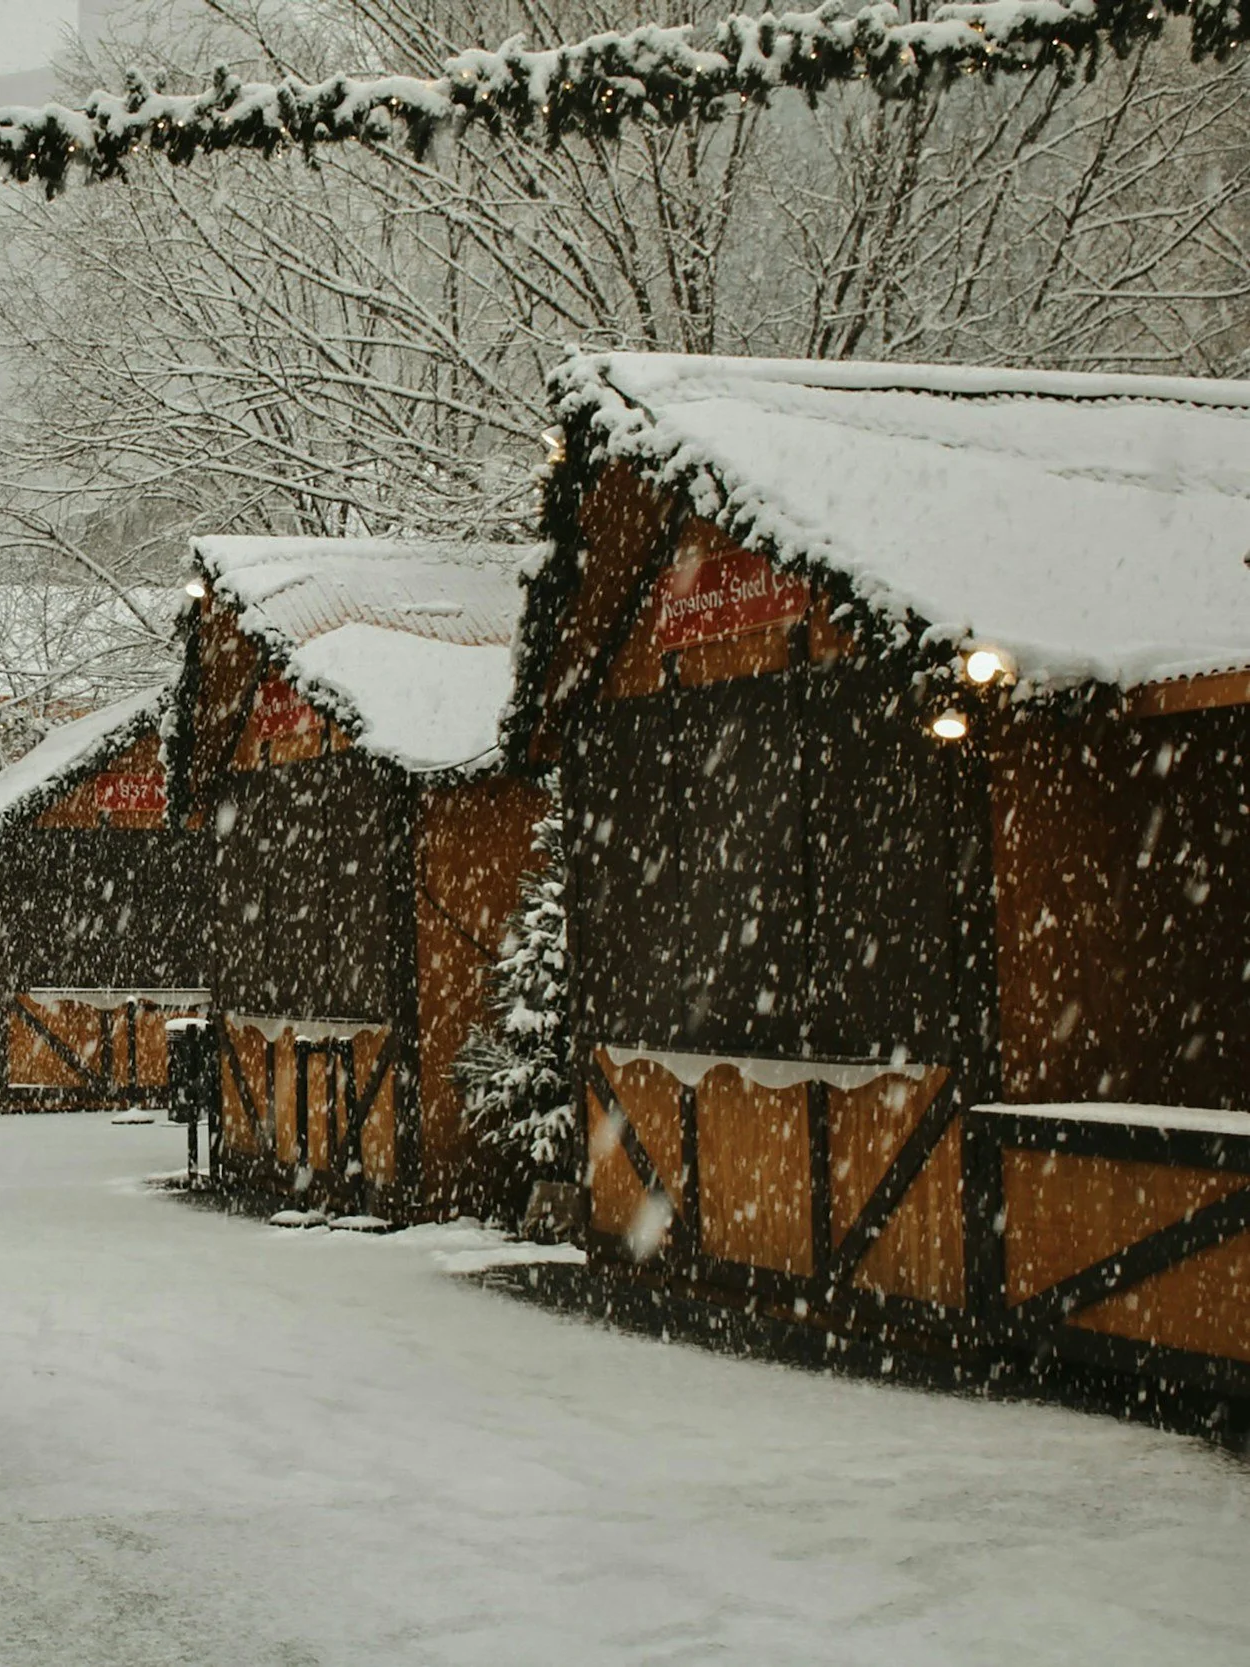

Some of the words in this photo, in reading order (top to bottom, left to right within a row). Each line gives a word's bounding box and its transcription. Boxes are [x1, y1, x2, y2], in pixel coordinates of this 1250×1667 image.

[662, 589, 725, 622] Keystone
[730, 570, 768, 604] Steel
[120, 784, 148, 799] 837
